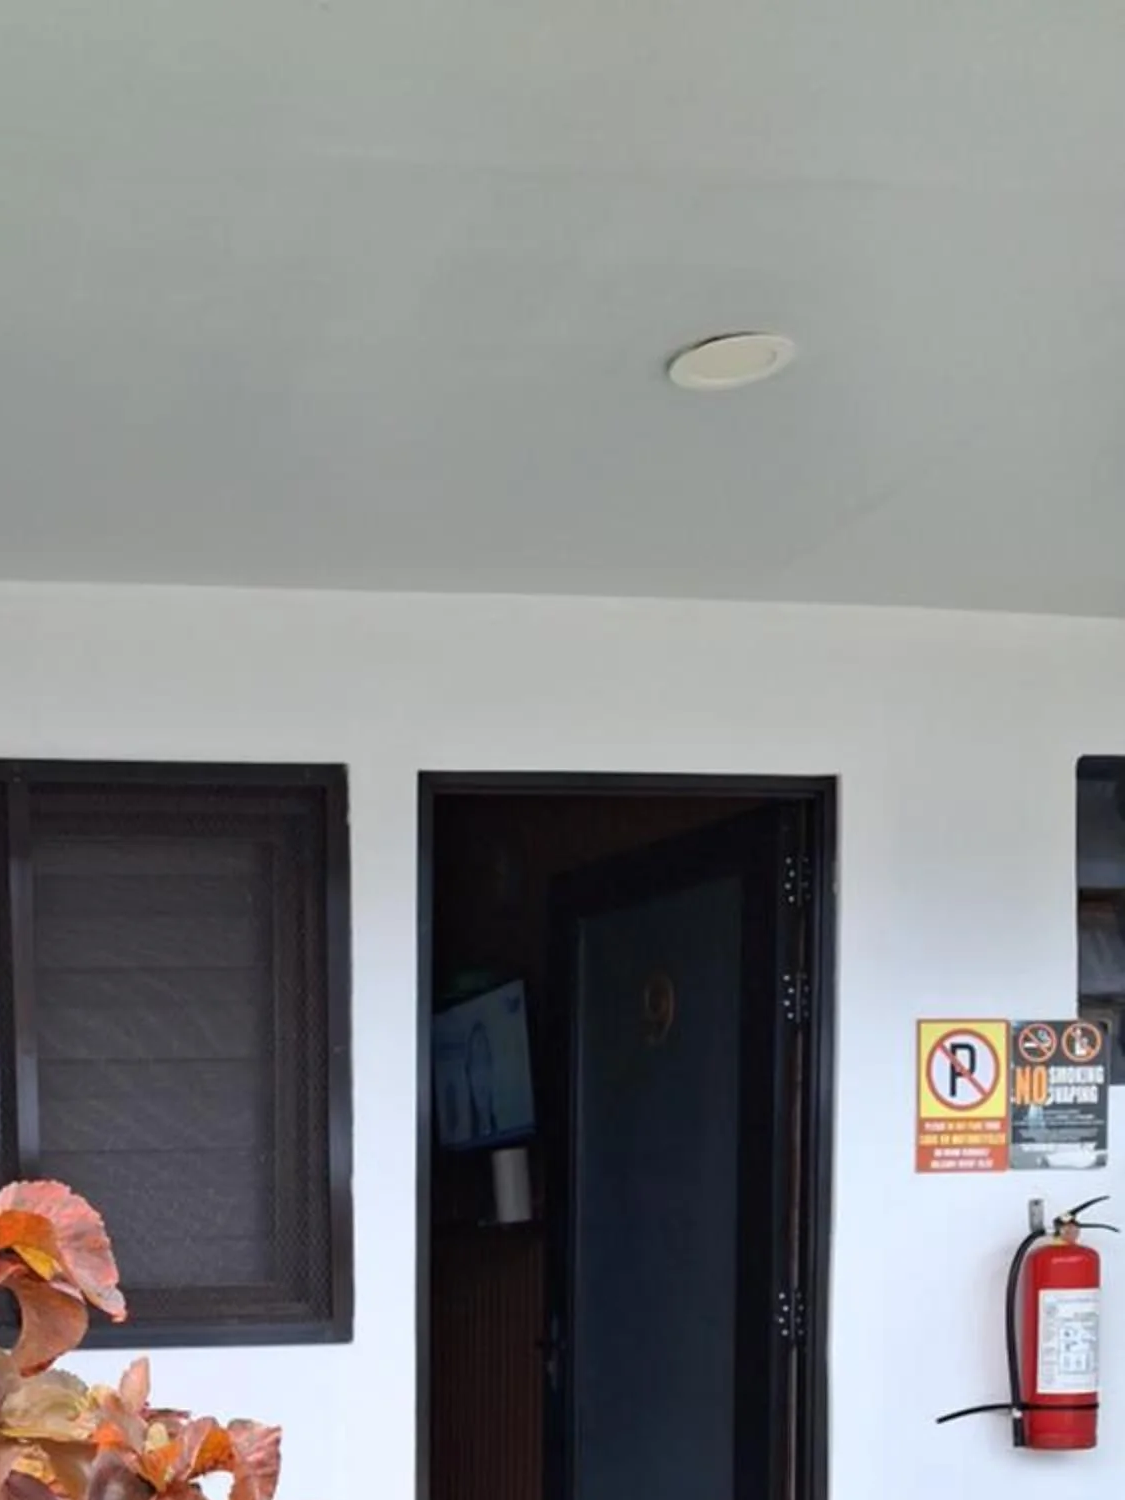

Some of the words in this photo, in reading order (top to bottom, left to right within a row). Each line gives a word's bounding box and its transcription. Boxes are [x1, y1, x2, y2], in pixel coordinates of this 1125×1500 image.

[642, 972, 676, 1046] 9
[949, 1042, 977, 1098] P
[1015, 1065, 1048, 1105] NO
[1049, 1066, 1105, 1084] SMOKING
